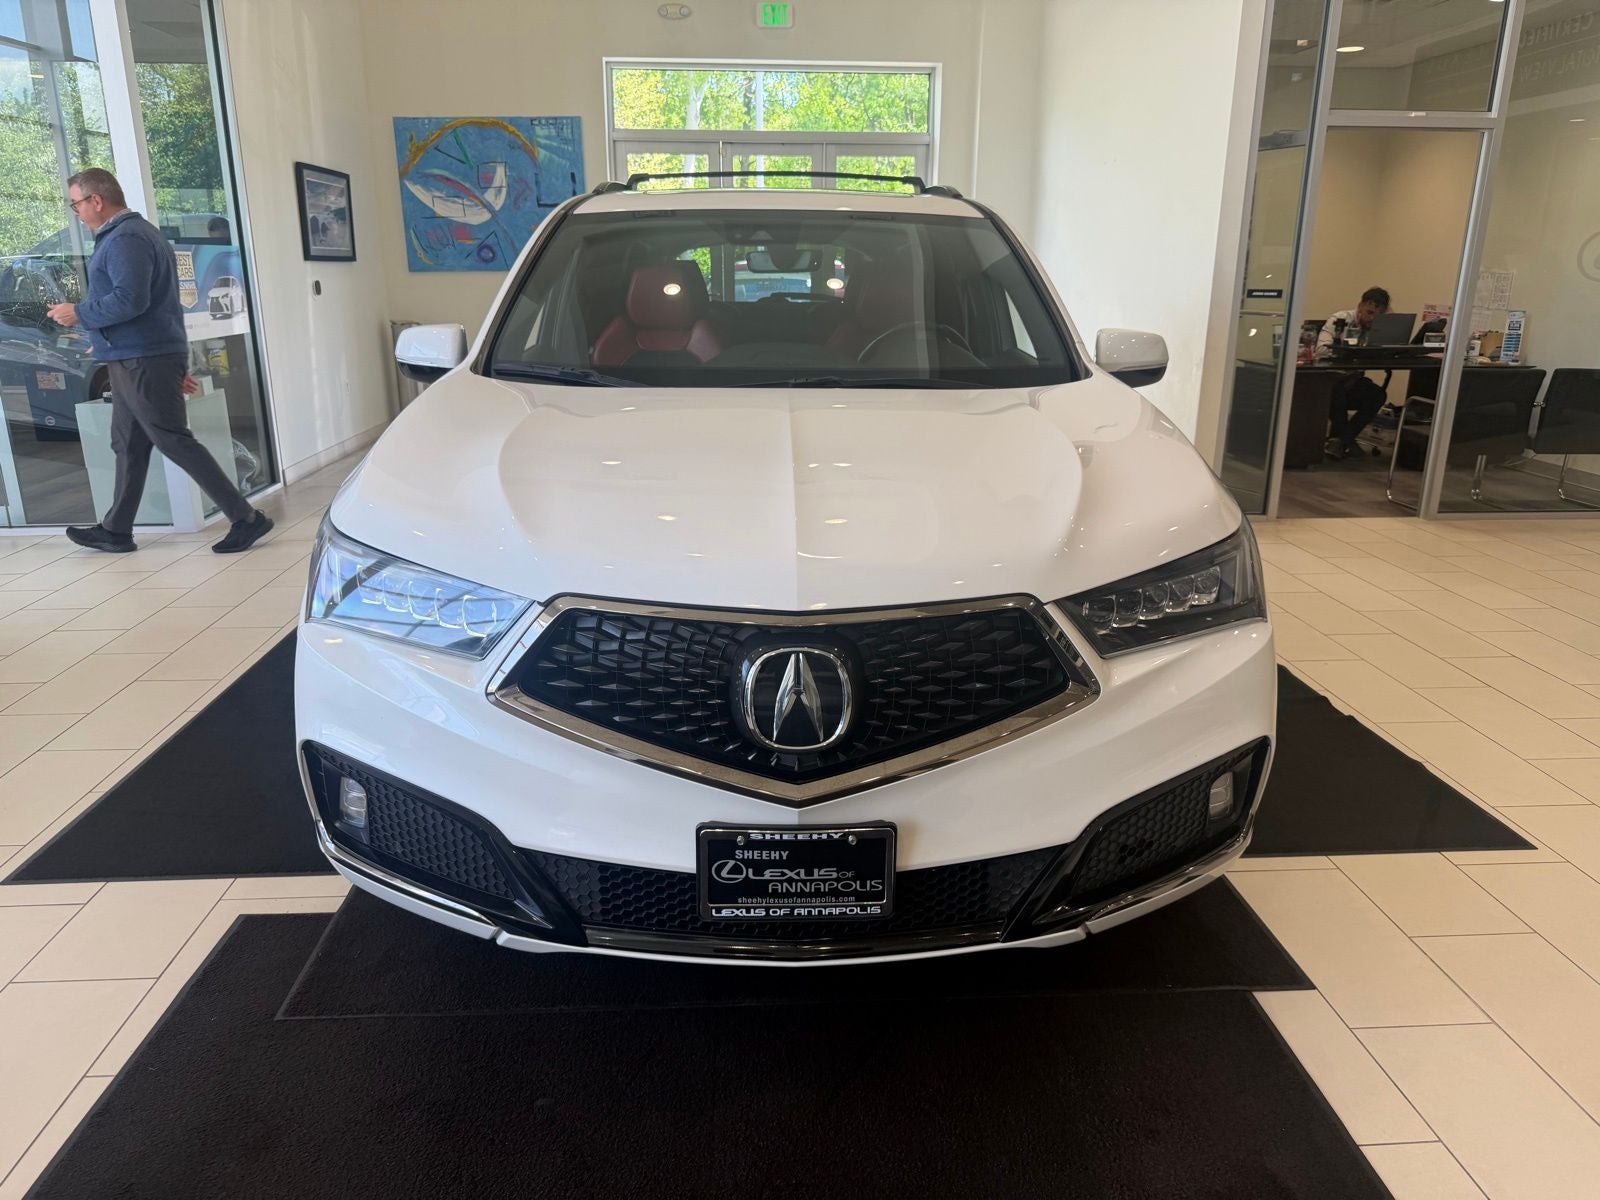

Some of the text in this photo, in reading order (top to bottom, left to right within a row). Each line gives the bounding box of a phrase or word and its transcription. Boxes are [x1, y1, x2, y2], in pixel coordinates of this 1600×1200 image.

[762, 2, 788, 25] EXIT
[749, 832, 844, 841] SHEEHY
[735, 849, 789, 860] SHEEHY
[748, 867, 856, 880] LEXUS OF
[768, 880, 883, 893] ANNAPOLIS
[738, 896, 856, 904] sheehylexusofannapolis.com
[712, 906, 882, 917] LEXUS OF ANNAPOLIS
